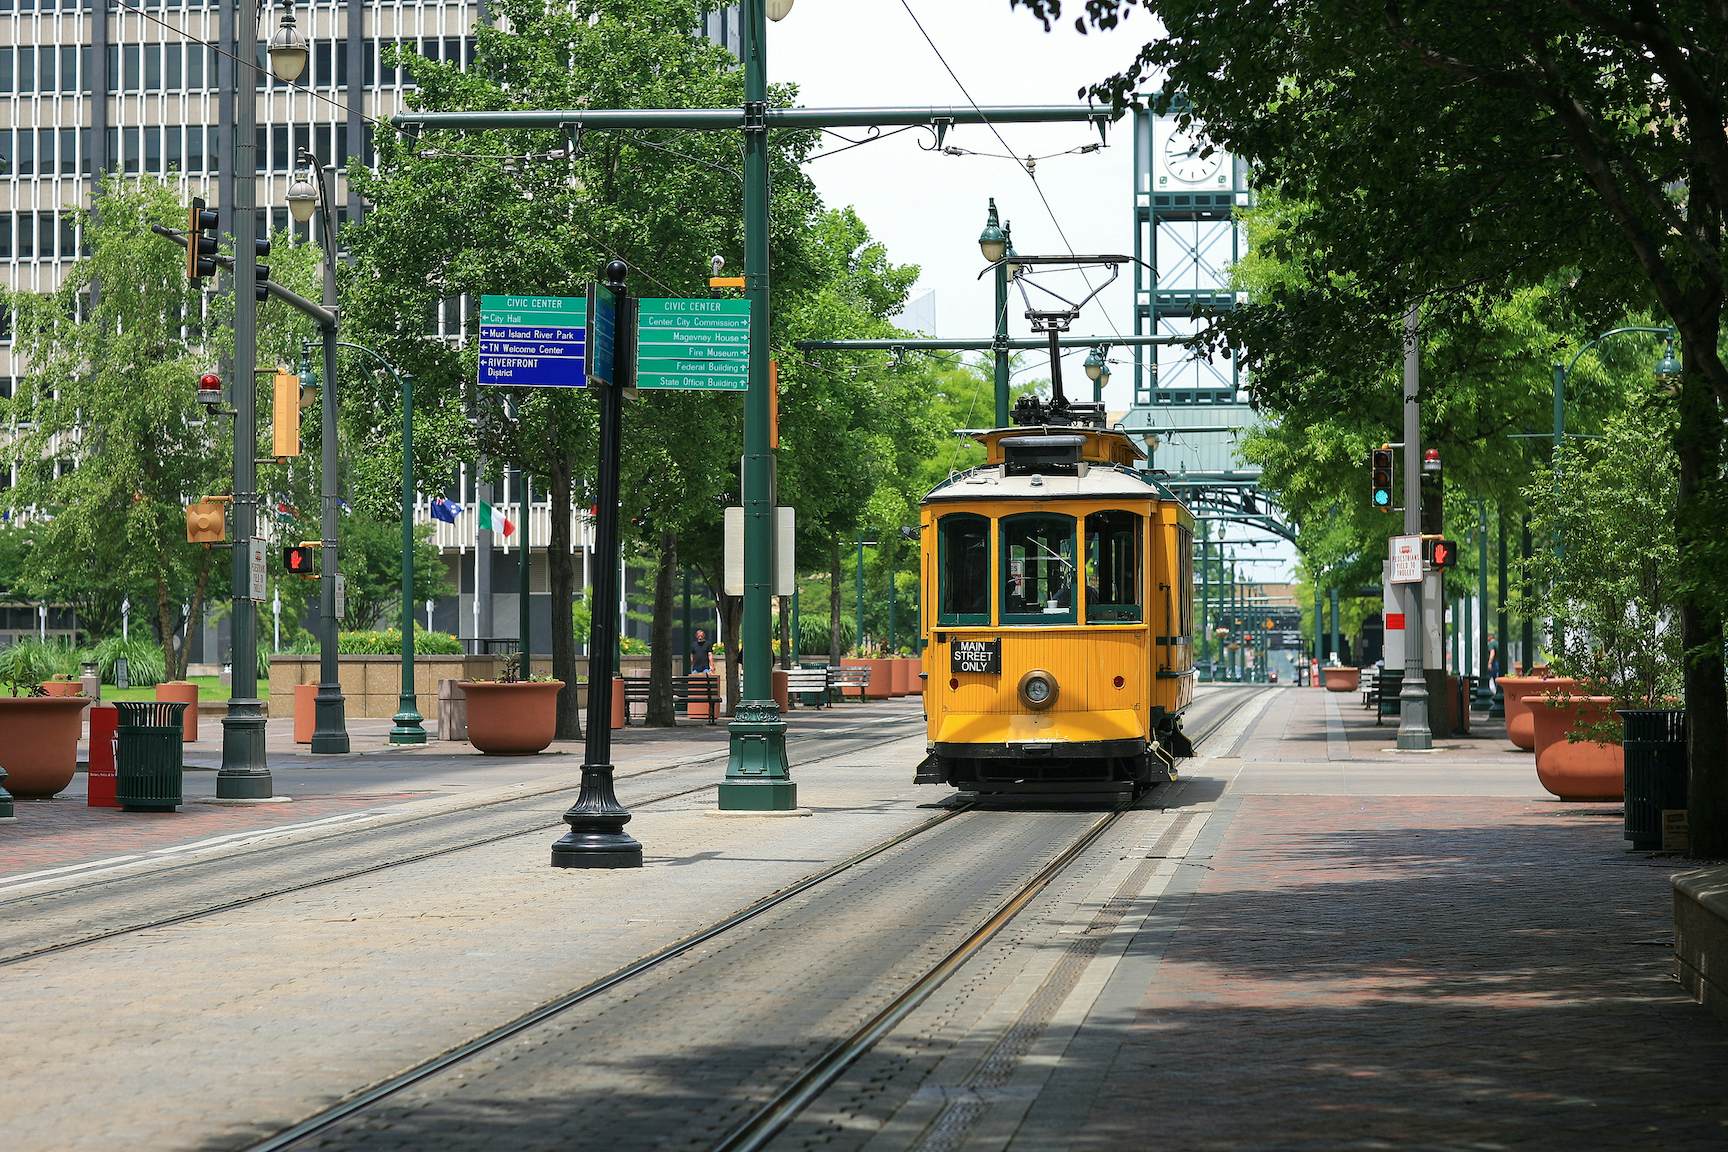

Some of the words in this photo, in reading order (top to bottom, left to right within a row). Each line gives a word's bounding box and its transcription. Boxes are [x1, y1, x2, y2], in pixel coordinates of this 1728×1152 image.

[507, 298, 528, 307] CIVIC
[532, 299, 562, 308] CENTER
[665, 302, 686, 310] CIVIC
[690, 302, 721, 311] CENTER
[490, 314, 504, 322] City
[507, 315, 521, 323] Hall
[649, 317, 673, 326] Center
[677, 317, 690, 326] City
[694, 317, 739, 327] Commission
[489, 329, 505, 338] Mud
[509, 329, 530, 338] Island
[534, 330, 553, 339] River
[557, 330, 573, 339] Park
[715, 333, 739, 342] House
[489, 343, 499, 352] TN
[503, 344, 536, 353] Welcome
[539, 345, 564, 354] Center
[689, 348, 703, 356] Fire
[707, 348, 739, 357] Museum
[488, 358, 538, 368] RIVERFRONT
[677, 362, 705, 370] Federal
[709, 363, 738, 372] Building
[488, 368, 512, 376] District
[660, 377, 679, 386] State
[683, 377, 704, 386] Office
[708, 378, 737, 388] Building
[961, 642, 985, 651] MAIN
[954, 651, 993, 661] STREET
[961, 662, 987, 672] ONLY
